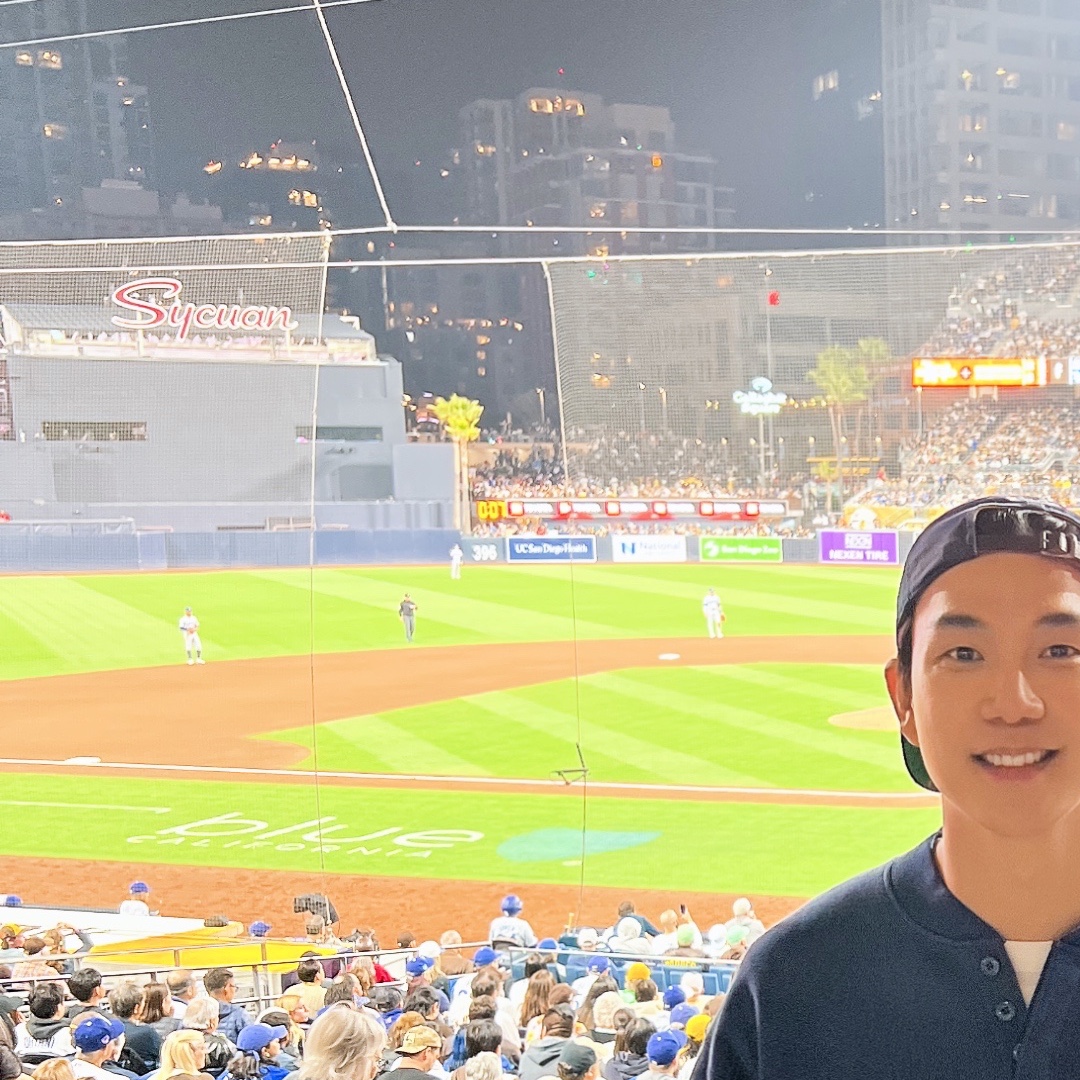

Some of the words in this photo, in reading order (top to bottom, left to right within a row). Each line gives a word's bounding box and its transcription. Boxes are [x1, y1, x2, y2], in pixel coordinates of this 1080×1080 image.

[111, 277, 299, 342] Sycuan
[829, 548, 864, 561] NEXEN
[865, 549, 889, 561] TIRE
[156, 812, 485, 848] blue
[126, 835, 432, 858] CALIFORNIA
